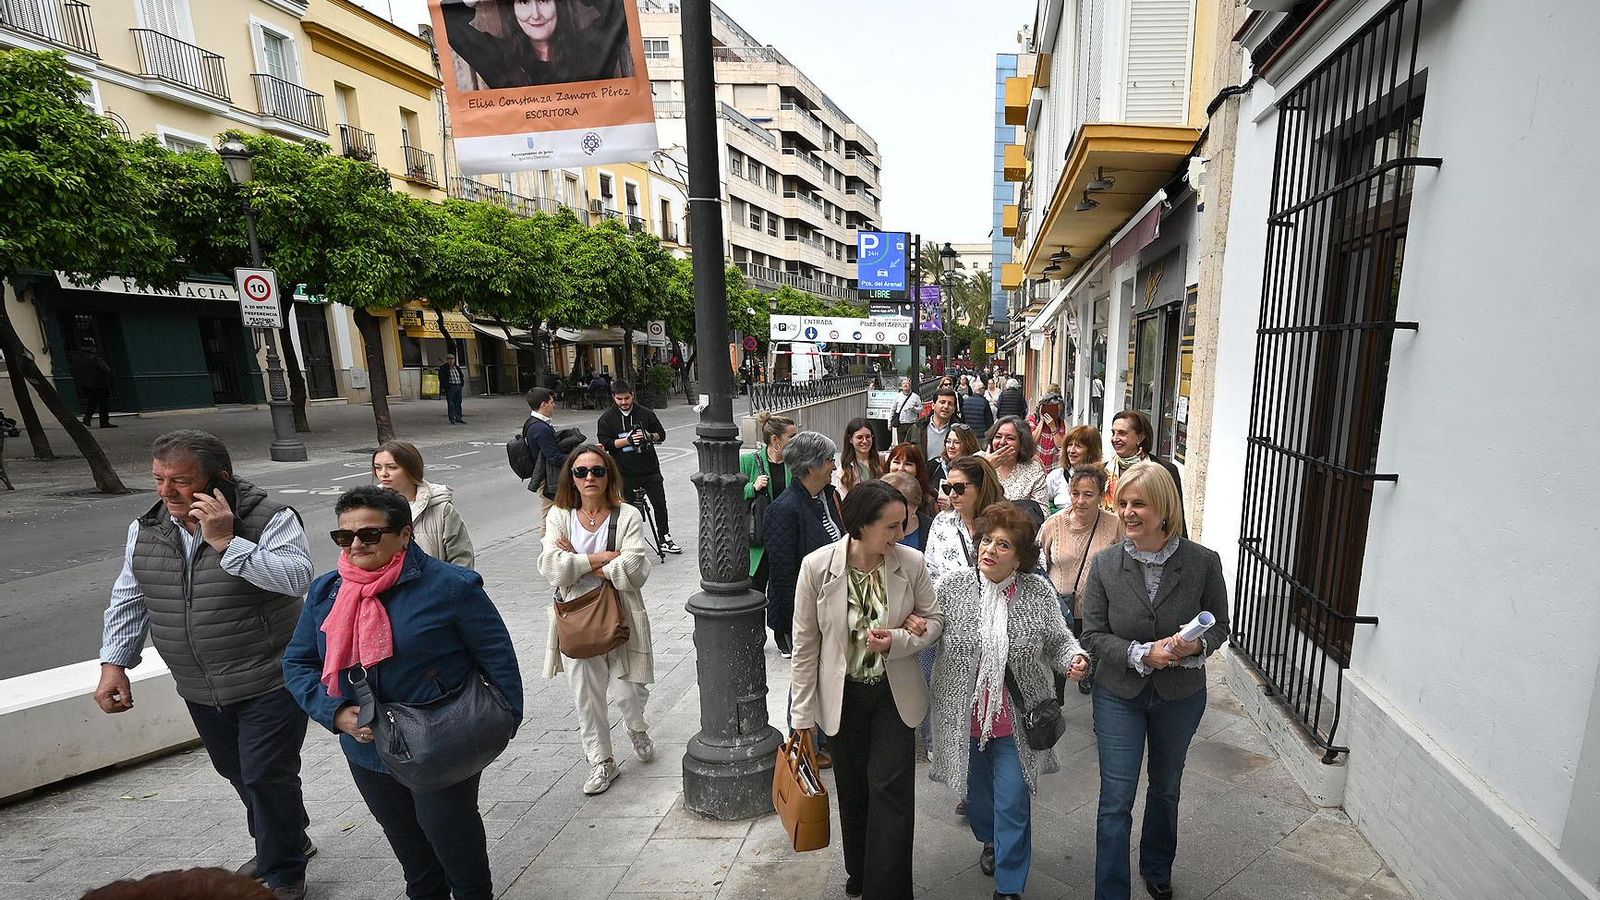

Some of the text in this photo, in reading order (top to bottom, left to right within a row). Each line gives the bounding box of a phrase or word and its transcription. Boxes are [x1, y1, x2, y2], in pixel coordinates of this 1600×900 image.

[468, 86, 631, 109] Elisa Constanza Zamora Pérez
[524, 108, 579, 120] ESCRITORA
[860, 234, 880, 258] P
[250, 284, 264, 293] 10
[870, 290, 891, 298] LIBRE
